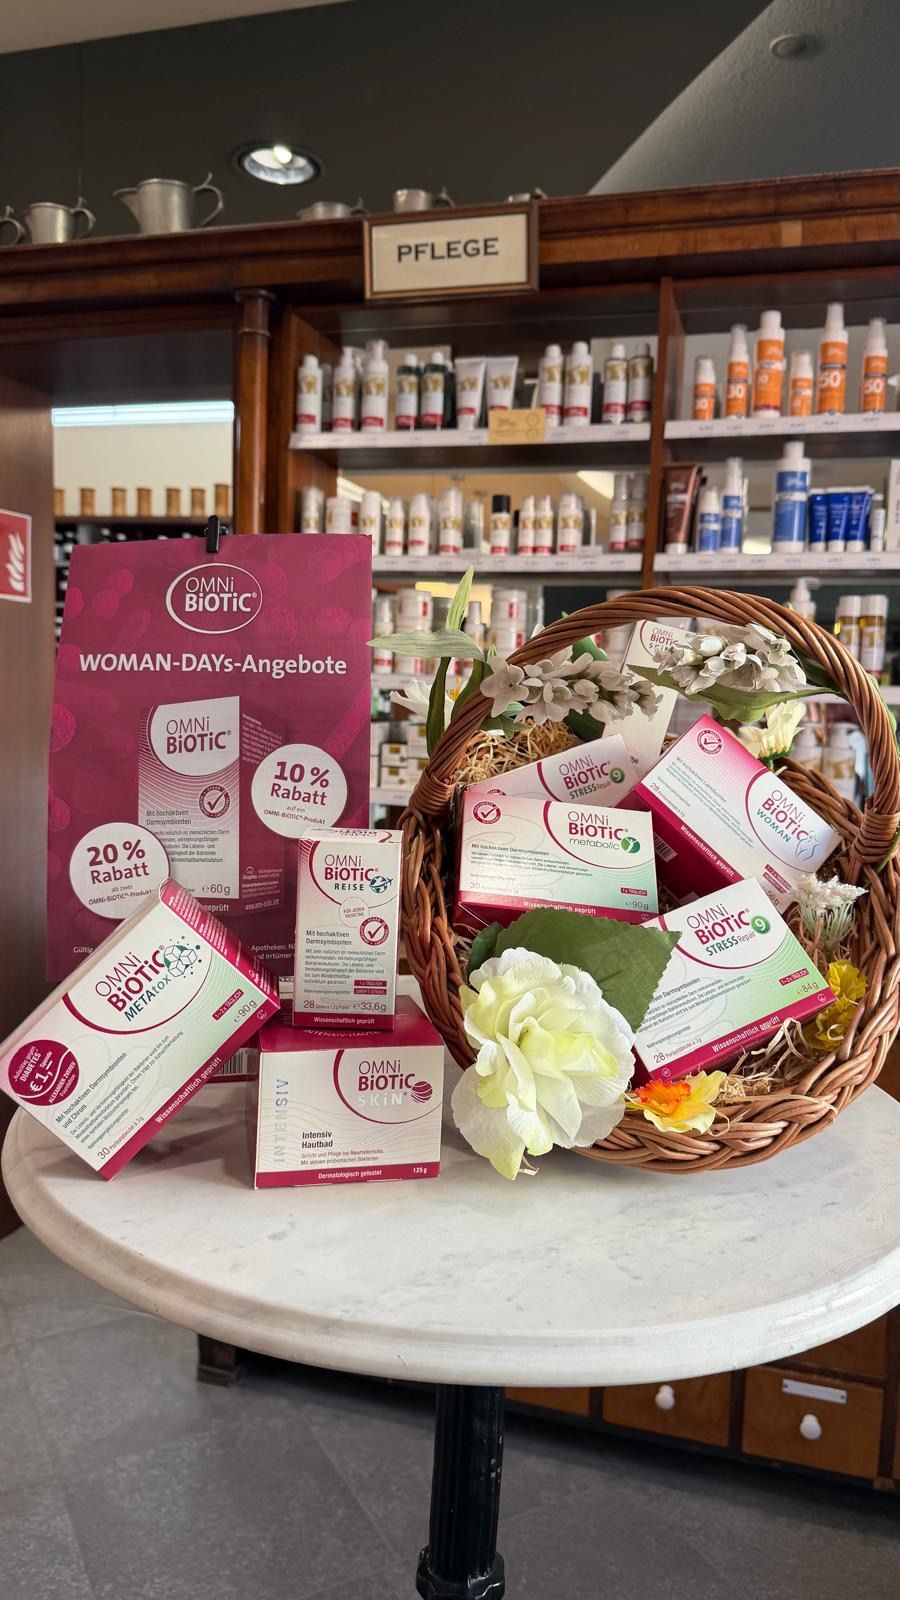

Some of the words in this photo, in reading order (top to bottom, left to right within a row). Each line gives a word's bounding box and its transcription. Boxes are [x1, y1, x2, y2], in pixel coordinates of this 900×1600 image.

[397, 237, 499, 263] PFLEGE
[185, 576, 235, 592] OMNi
[79, 653, 347, 679] WOMAN-DAYs-Angebote
[166, 715, 210, 735] OMNi
[274, 761, 305, 783] 10
[310, 767, 330, 788] %
[559, 755, 594, 776] OMNi
[270, 783, 327, 806] Rabatt
[569, 785, 597, 799] STRESS
[771, 789, 806, 822] OMNi
[567, 811, 609, 826] OMNi
[755, 808, 792, 843] WOMAN
[87, 844, 118, 867] 20
[123, 839, 145, 860] %
[569, 837, 621, 850] metabolic
[678, 824, 719, 861] Wissenschaftlich
[325, 854, 362, 867] OMNi
[91, 862, 149, 884] Rabatt
[686, 903, 730, 929] OMNi
[706, 936, 739, 956] STRESS
[739, 931, 755, 944] Repair
[95, 952, 142, 997] OMNi
[124, 973, 172, 1021] METAtox
[662, 975, 700, 997] Darmsymbionten
[238, 1004, 251, 1019] 90
[304, 1000, 315, 1008] 28
[361, 1002, 379, 1011] 33,6
[711, 1024, 759, 1053] Wissenschaftlich
[758, 1015, 780, 1031] geprüft
[358, 1060, 401, 1074] OMNi
[652, 1051, 666, 1063] 28
[55, 1112, 65, 1123] Mit
[62, 1087, 92, 1115] hochaktiven
[88, 1051, 128, 1090] Darmsymbionten
[153, 1076, 203, 1124] Wissenschaftlich
[198, 1056, 224, 1080] geprüft
[358, 1074, 415, 1091] BiOTiC
[61, 1117, 73, 1128] und
[70, 1103, 87, 1120] Chrom
[274, 1079, 289, 1163] INTENSIV
[302, 1131, 332, 1139] Intensiv
[302, 1140, 333, 1149] Hautbad
[96, 1146, 110, 1160] 30
[318, 1171, 360, 1179] Dermatologisch
[360, 1169, 382, 1177] getestet
